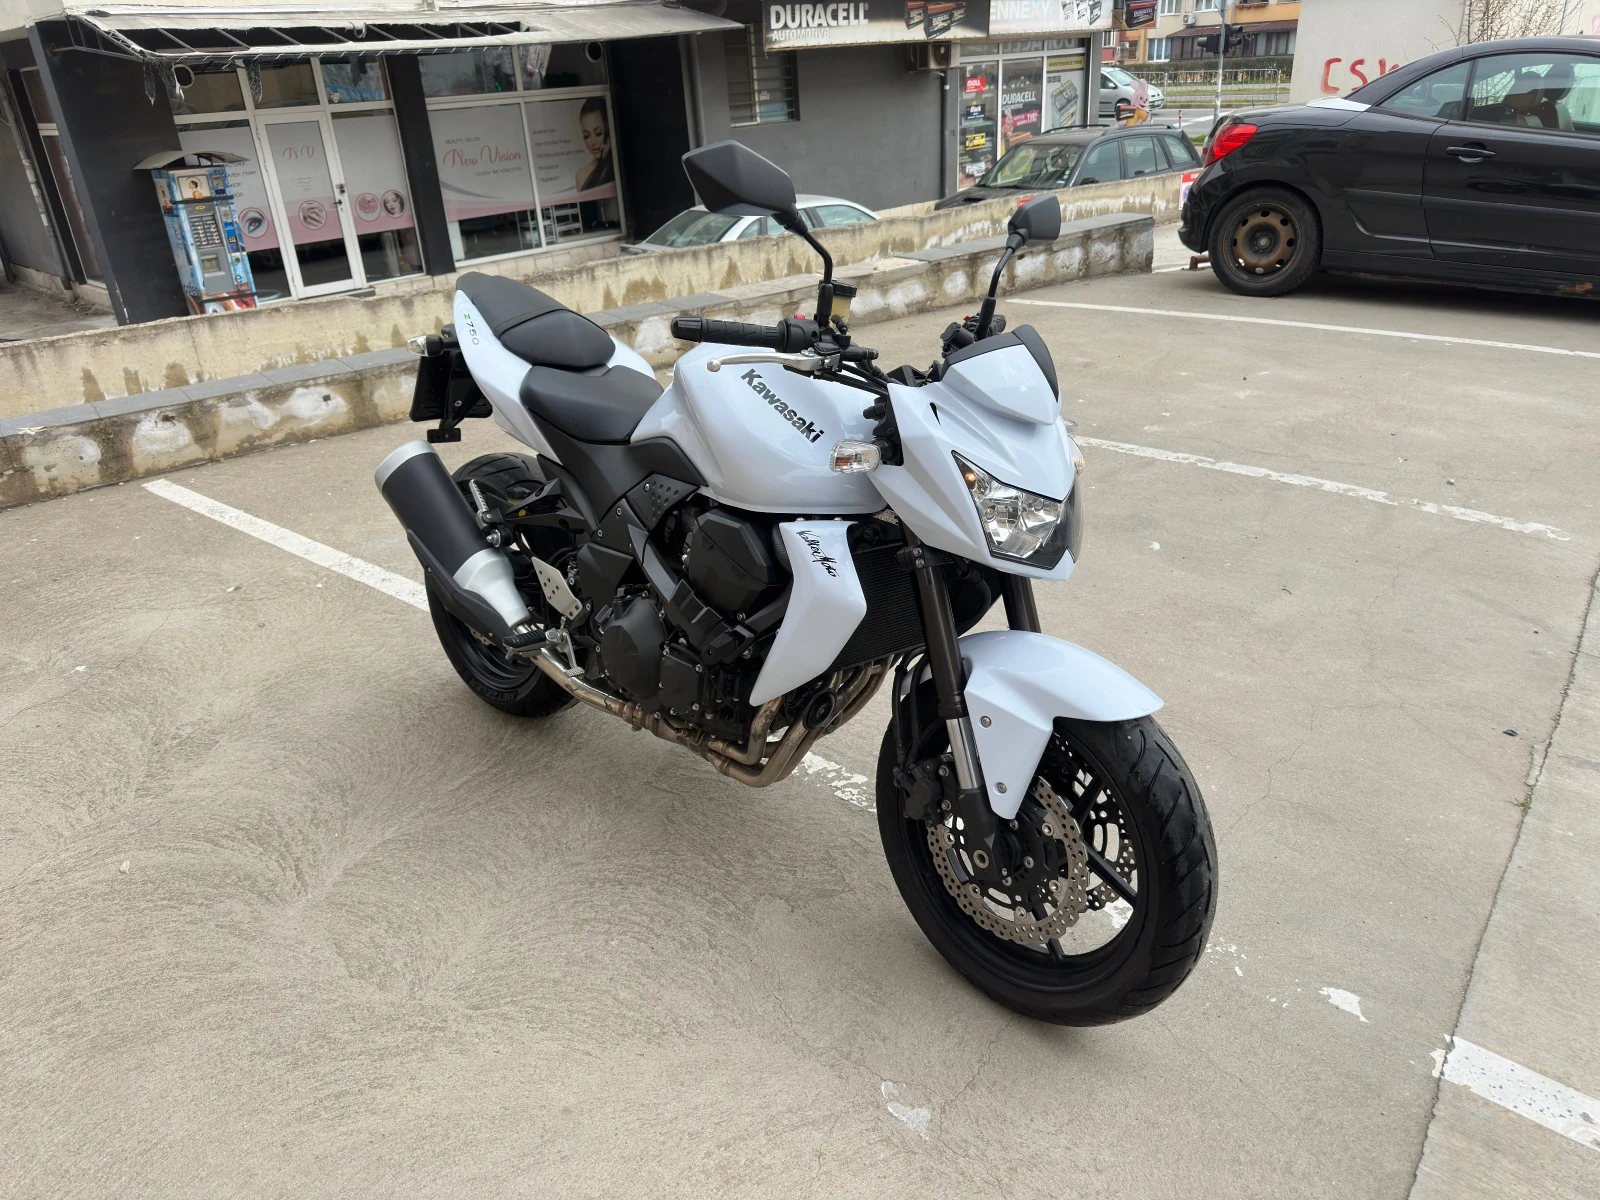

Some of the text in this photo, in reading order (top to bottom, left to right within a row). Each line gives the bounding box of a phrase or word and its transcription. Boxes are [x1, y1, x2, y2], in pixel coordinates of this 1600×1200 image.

[770, 3, 868, 29] DURACELL
[772, 28, 830, 41] AUTOMOTIVE
[1002, 91, 1036, 105] DURACELL
[443, 145, 521, 168] New Vision
[463, 313, 479, 345] Z750
[740, 368, 825, 443] Kawasaki
[469, 677, 517, 702] METZELER
